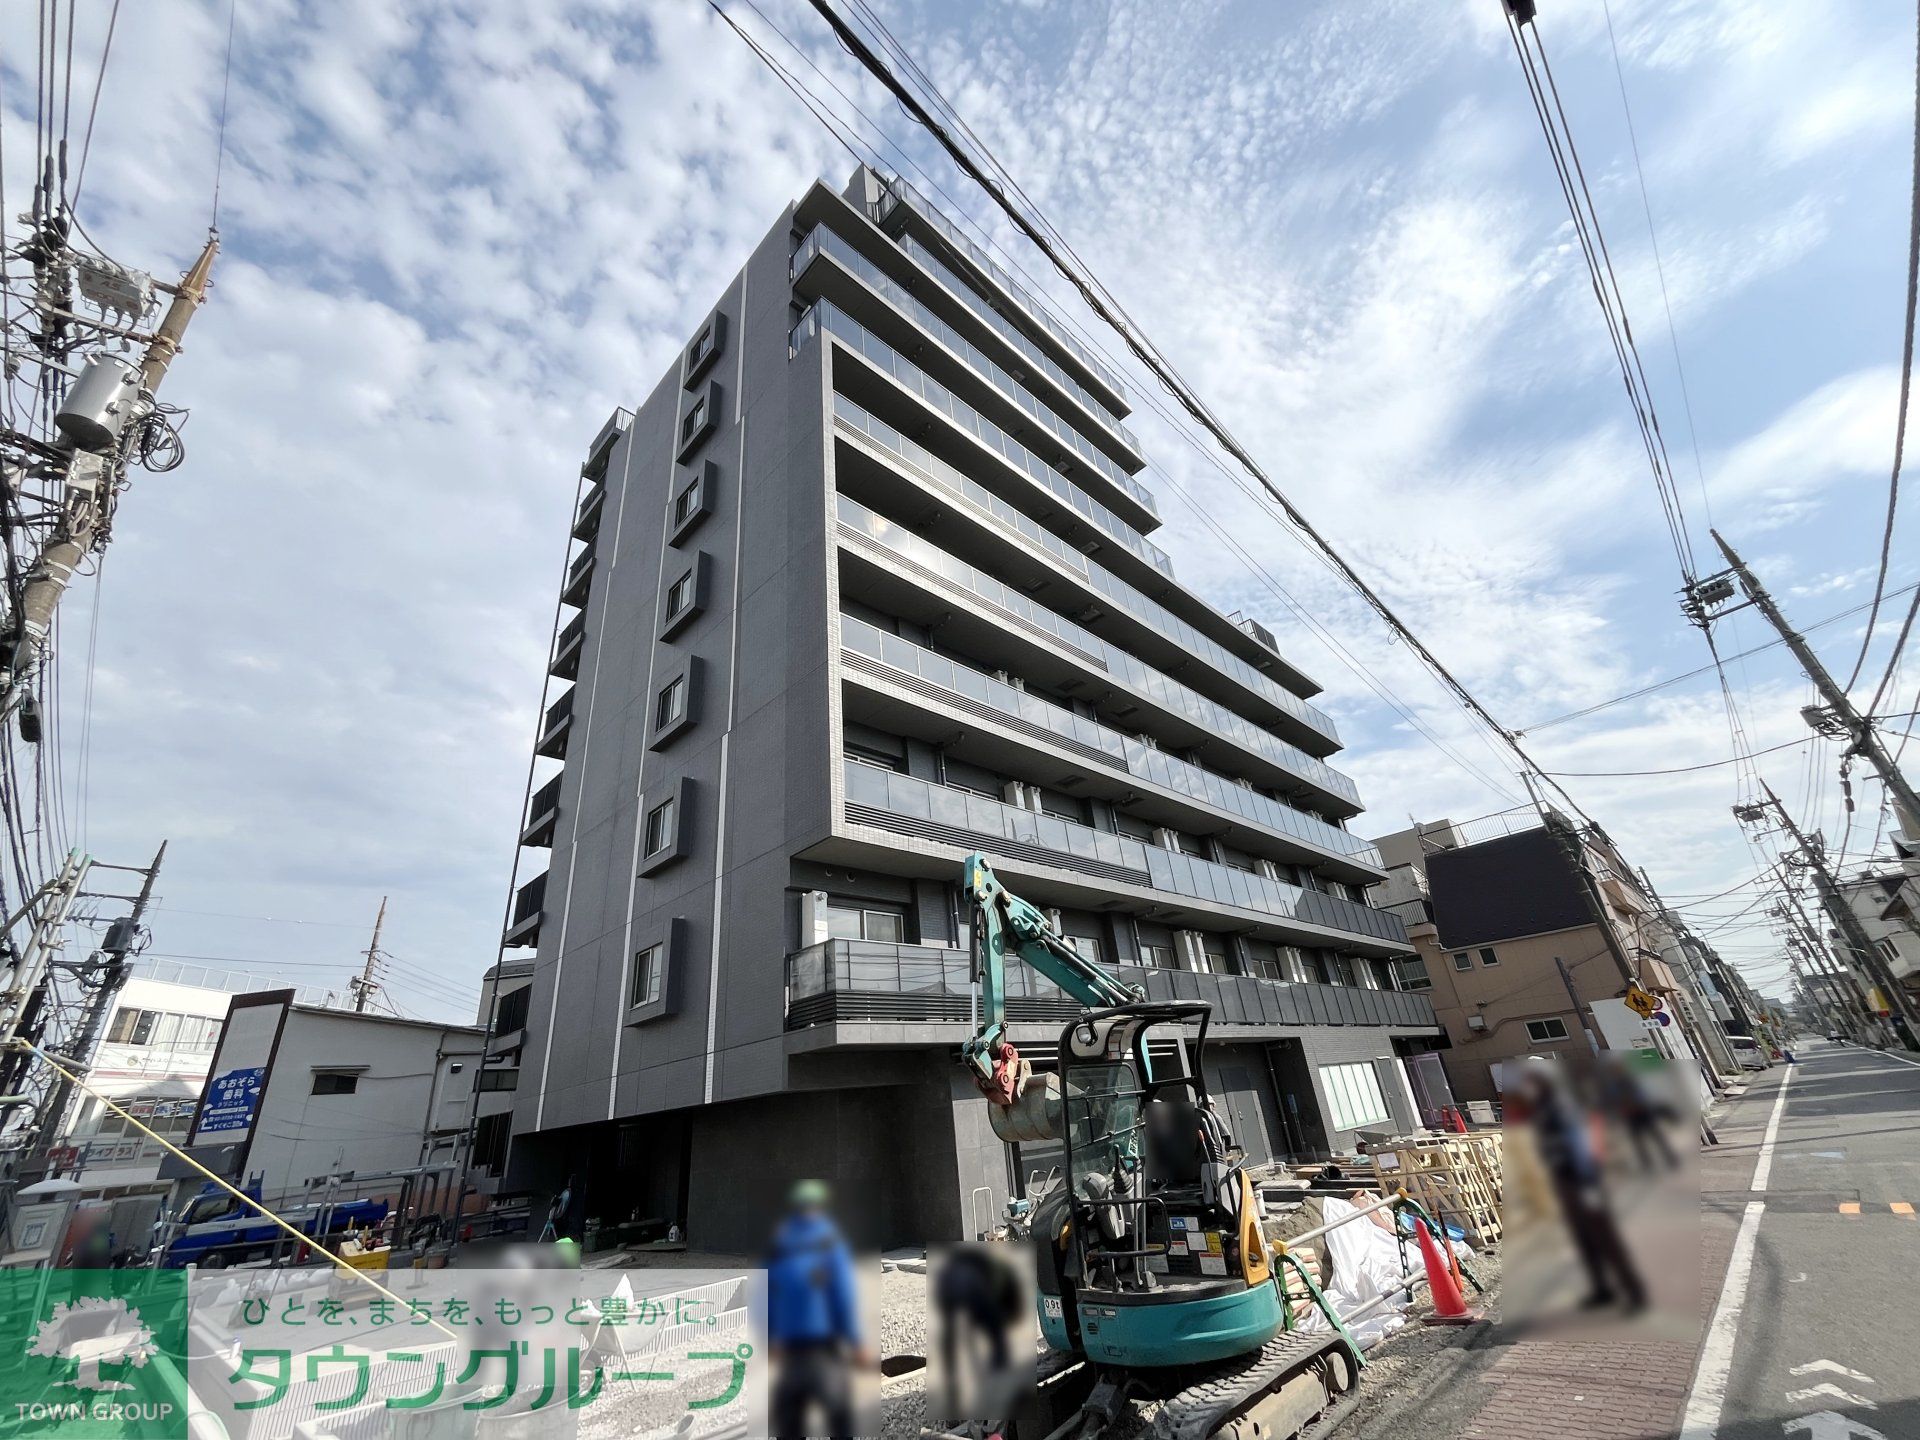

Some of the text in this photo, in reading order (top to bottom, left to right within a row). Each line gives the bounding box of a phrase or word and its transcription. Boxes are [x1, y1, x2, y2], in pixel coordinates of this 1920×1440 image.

[218, 1076, 255, 1090] あおぞら
[223, 1088, 244, 1101] 歯科
[217, 1099, 244, 1108] クリニック
